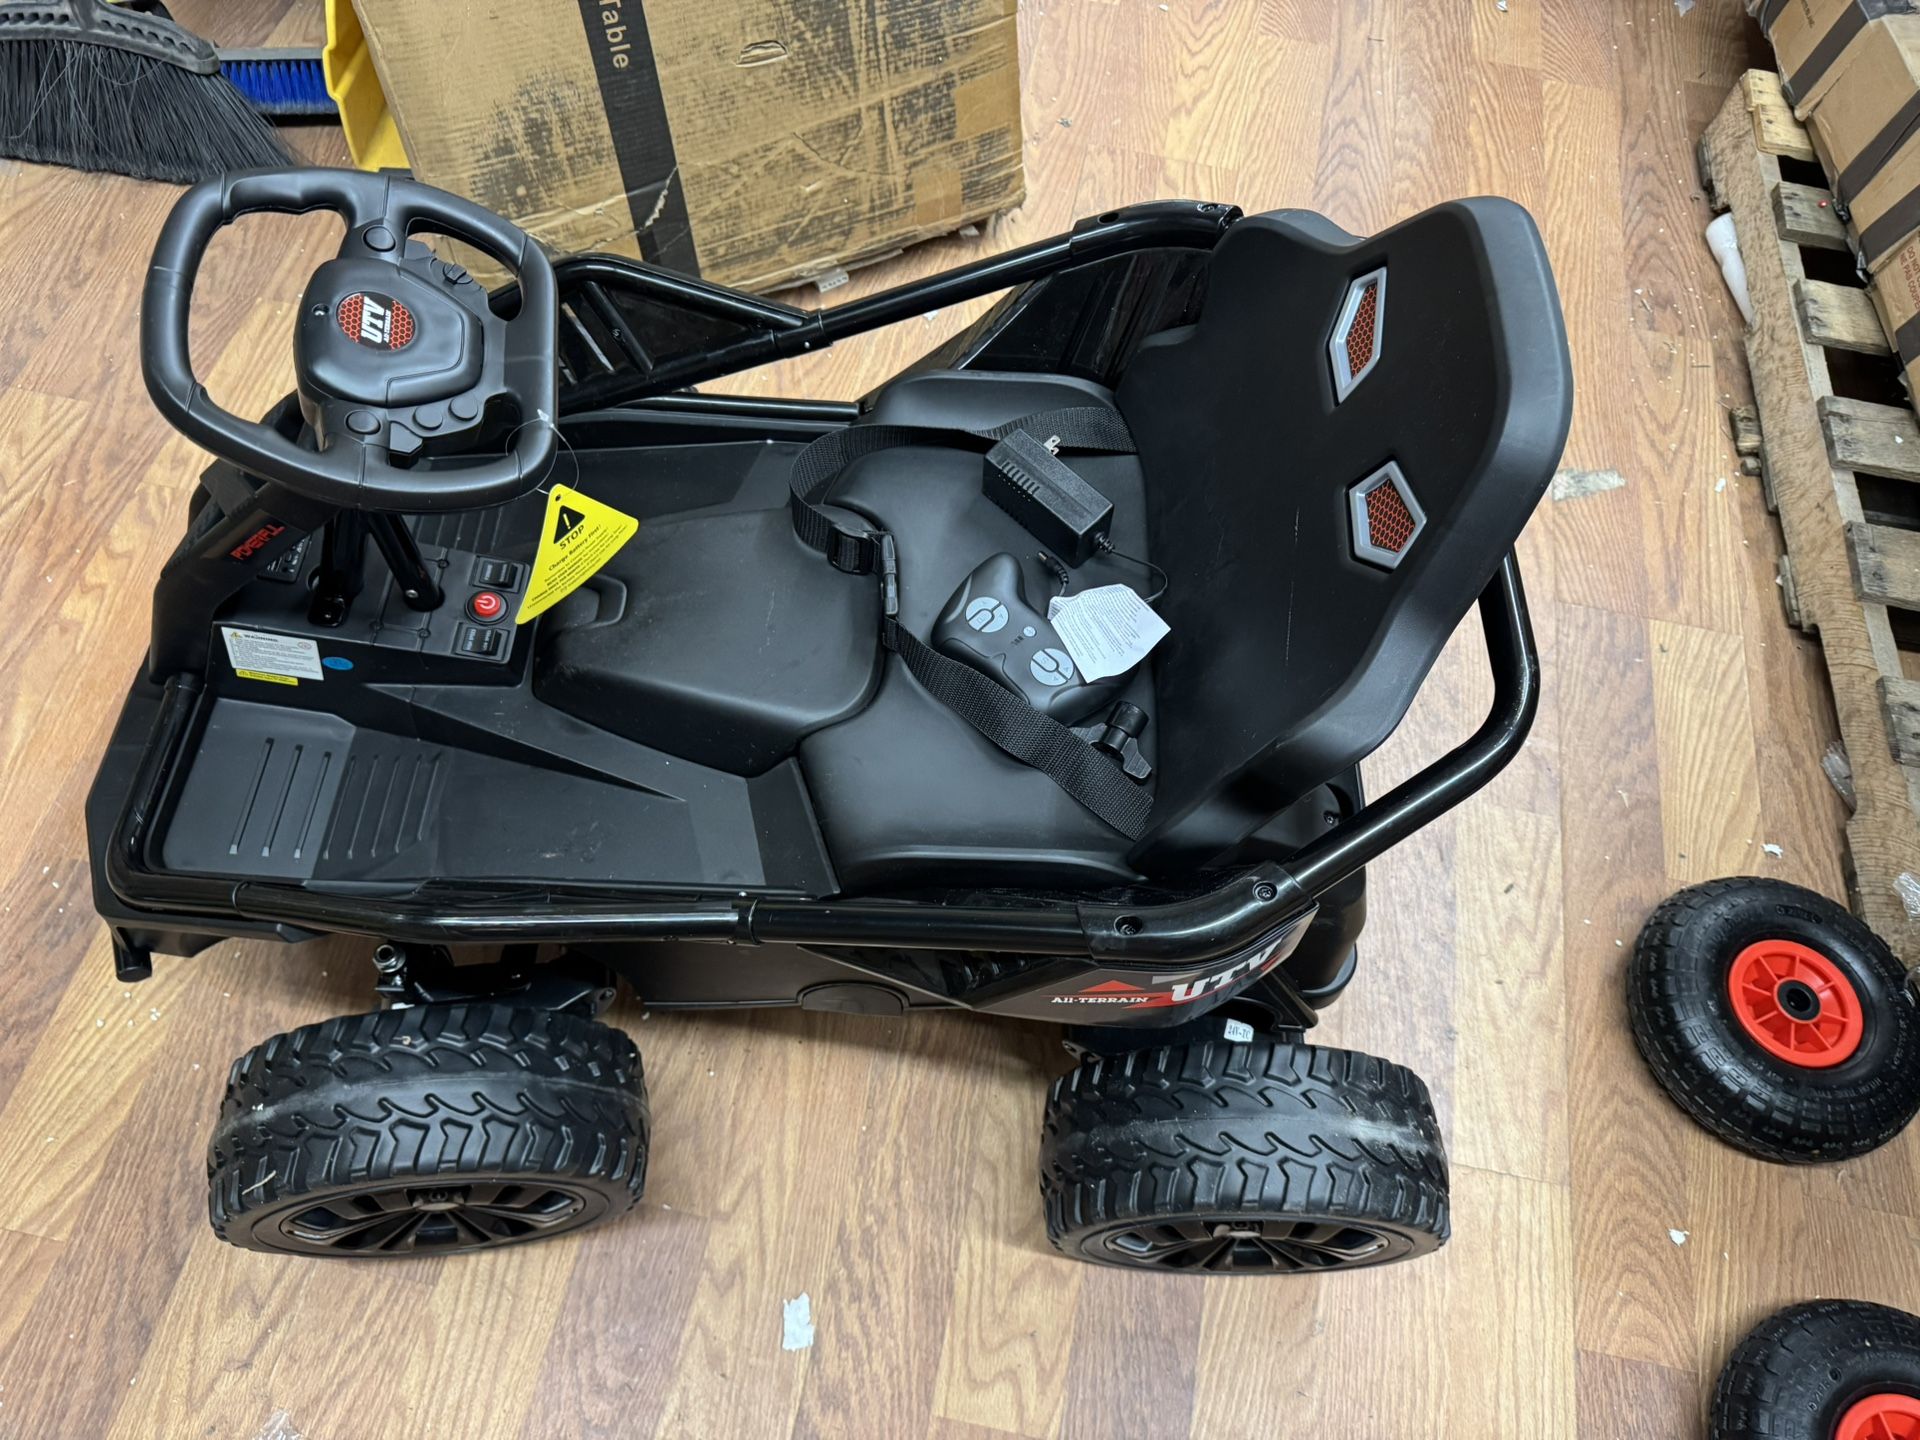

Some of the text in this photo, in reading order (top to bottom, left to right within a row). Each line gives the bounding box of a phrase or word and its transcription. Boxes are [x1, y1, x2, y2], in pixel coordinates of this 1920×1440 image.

[599, 0, 631, 68] Table
[361, 296, 384, 343] UTV
[549, 555, 569, 571] Charge
[569, 538, 587, 555] Battery
[560, 525, 584, 550] STOP
[1172, 938, 1283, 1002] UTV
